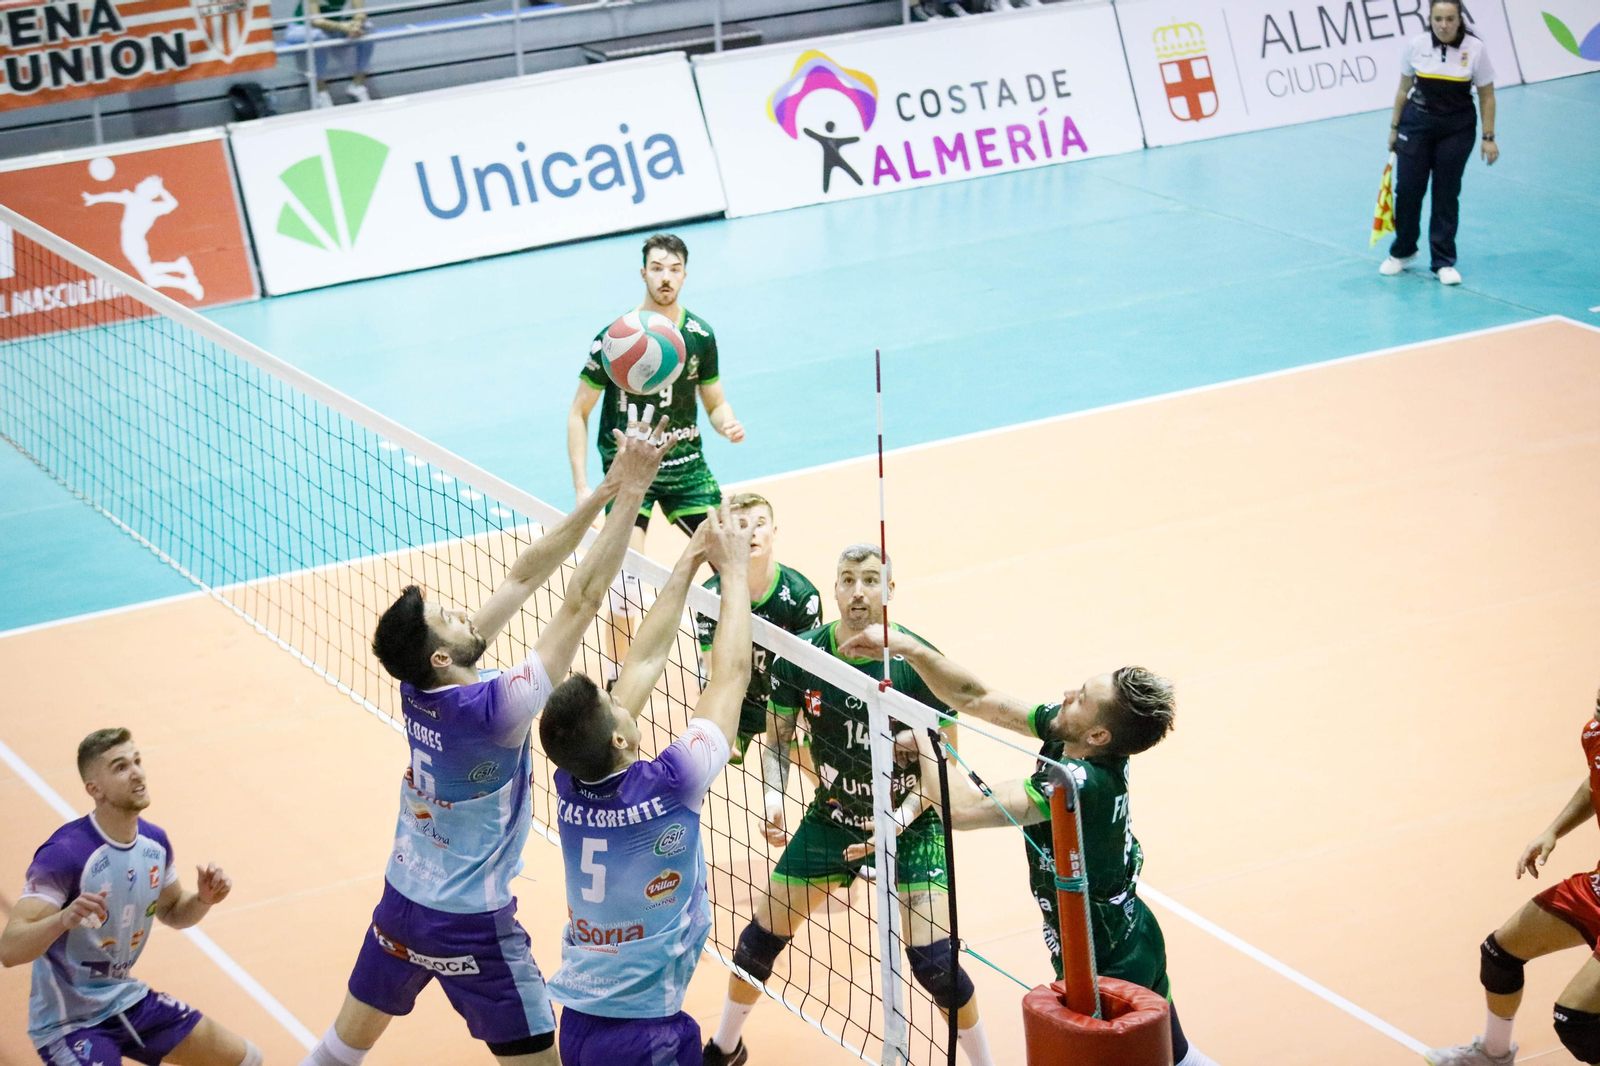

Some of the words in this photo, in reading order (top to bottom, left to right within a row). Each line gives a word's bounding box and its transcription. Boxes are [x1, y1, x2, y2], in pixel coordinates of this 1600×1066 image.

[1261, 0, 1475, 58] ALMER
[4, 32, 188, 92] UNION
[1265, 55, 1378, 98] CIUDAD
[896, 80, 1017, 122] COSTA
[1025, 69, 1072, 103] DE
[872, 107, 1088, 187] ALMERÍA
[415, 123, 685, 220] Unicaja
[659, 384, 673, 408] 9
[843, 719, 871, 751] 14
[412, 747, 437, 802] 6
[842, 772, 917, 797] Uniaja
[586, 796, 667, 828] LORENTE
[660, 826, 686, 847] CSIF
[581, 837, 608, 904] 5
[648, 878, 678, 894] Villar
[576, 919, 644, 946] Soria
[568, 967, 592, 983] Soria
[593, 975, 621, 988] puro
